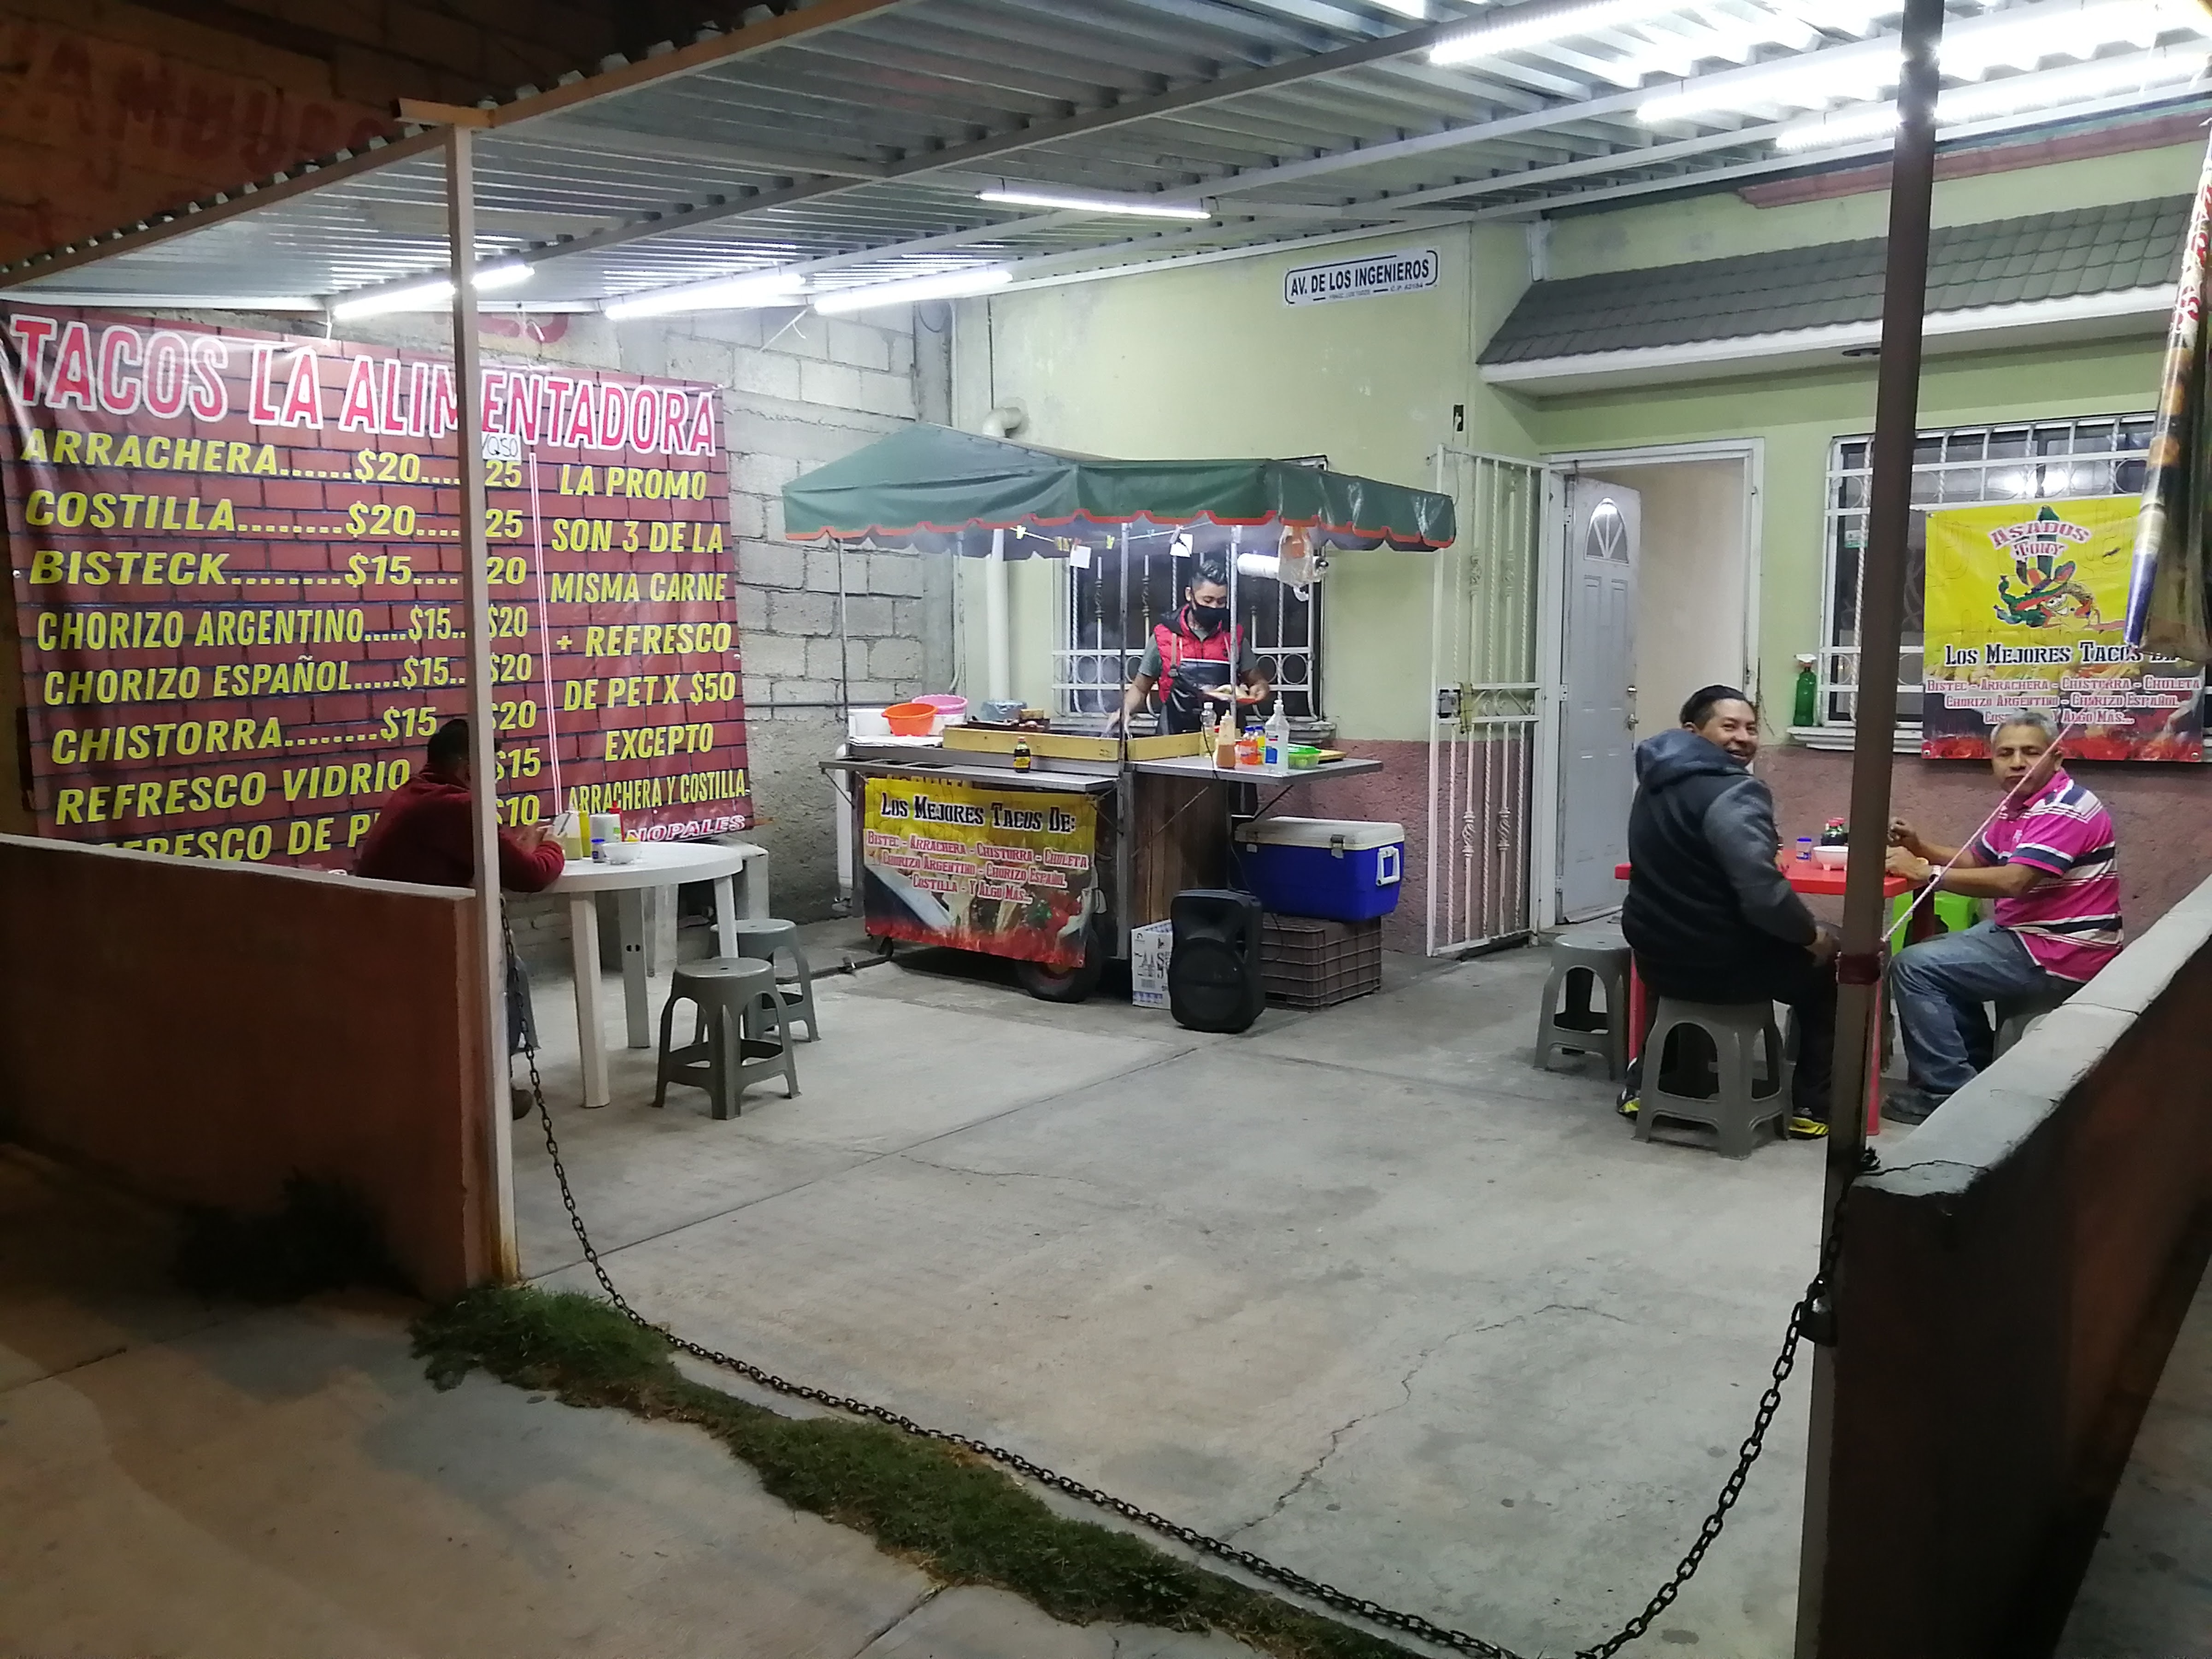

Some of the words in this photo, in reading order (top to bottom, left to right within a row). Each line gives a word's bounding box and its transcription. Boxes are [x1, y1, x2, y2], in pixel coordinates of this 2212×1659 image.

[1291, 276, 1307, 296] AV.
[1311, 274, 1325, 294] DE
[1330, 270, 1351, 290] LOS
[1355, 259, 1429, 287] INGENIEROS
[10, 313, 229, 423] TACOS
[248, 343, 324, 429] LA
[338, 354, 716, 457] ALIMENTADORA
[559, 464, 595, 497] LA
[606, 467, 707, 501] PROMO
[552, 518, 612, 553] SON
[622, 521, 640, 553] 3
[649, 522, 686, 552] DE
[692, 524, 724, 553] LA
[1991, 522, 2089, 545] ASADOS
[551, 573, 640, 603] MISMA
[650, 573, 728, 603] CARNE
[38, 611, 184, 651] CHORIZO
[488, 603, 528, 641] $20
[557, 635, 572, 650] +
[585, 623, 732, 658] REFRESCO
[1946, 645, 1978, 665] LOS
[1986, 644, 2071, 664] MEJORES
[2080, 641, 2141, 662] TACOS
[44, 666, 200, 706] CHORIZO
[490, 652, 532, 686] $20
[564, 679, 597, 712] DE
[607, 676, 658, 709] PET
[662, 675, 680, 705] X
[690, 671, 736, 707] $50
[1927, 680, 1967, 691] BISTEC
[1981, 678, 2048, 690] ARRACHERA
[2062, 677, 2130, 689] CHISTORRA
[2145, 677, 2200, 689] CHULETA
[1946, 695, 1992, 707] CHORIZO
[1997, 695, 2058, 706] ARGENTINO
[2074, 693, 2122, 706] CHORIZO
[2064, 710, 2093, 723] ALGO
[605, 723, 714, 763] EXCEPTO
[55, 771, 267, 826] REFRESCO
[282, 759, 410, 802] VIDRIO
[569, 777, 662, 813] ARRACHERA
[666, 776, 676, 805] Y
[680, 769, 745, 803] COSTILLA
[625, 815, 745, 842] NOPALES
[882, 792, 908, 817] LOS
[914, 795, 984, 824] MEJORES
[991, 802, 1042, 830] TACOS
[288, 818, 334, 855] DE
[868, 831, 899, 847] BISTEC
[910, 835, 966, 854] ARRACHERA
[977, 843, 1032, 862] CHISTORRA
[913, 874, 957, 892] COSTILLA
[970, 880, 977, 894] Y
[979, 881, 1002, 898] ALGO
[924, 856, 975, 875] ARGENTINO
[986, 863, 1027, 881] CHORIZO
